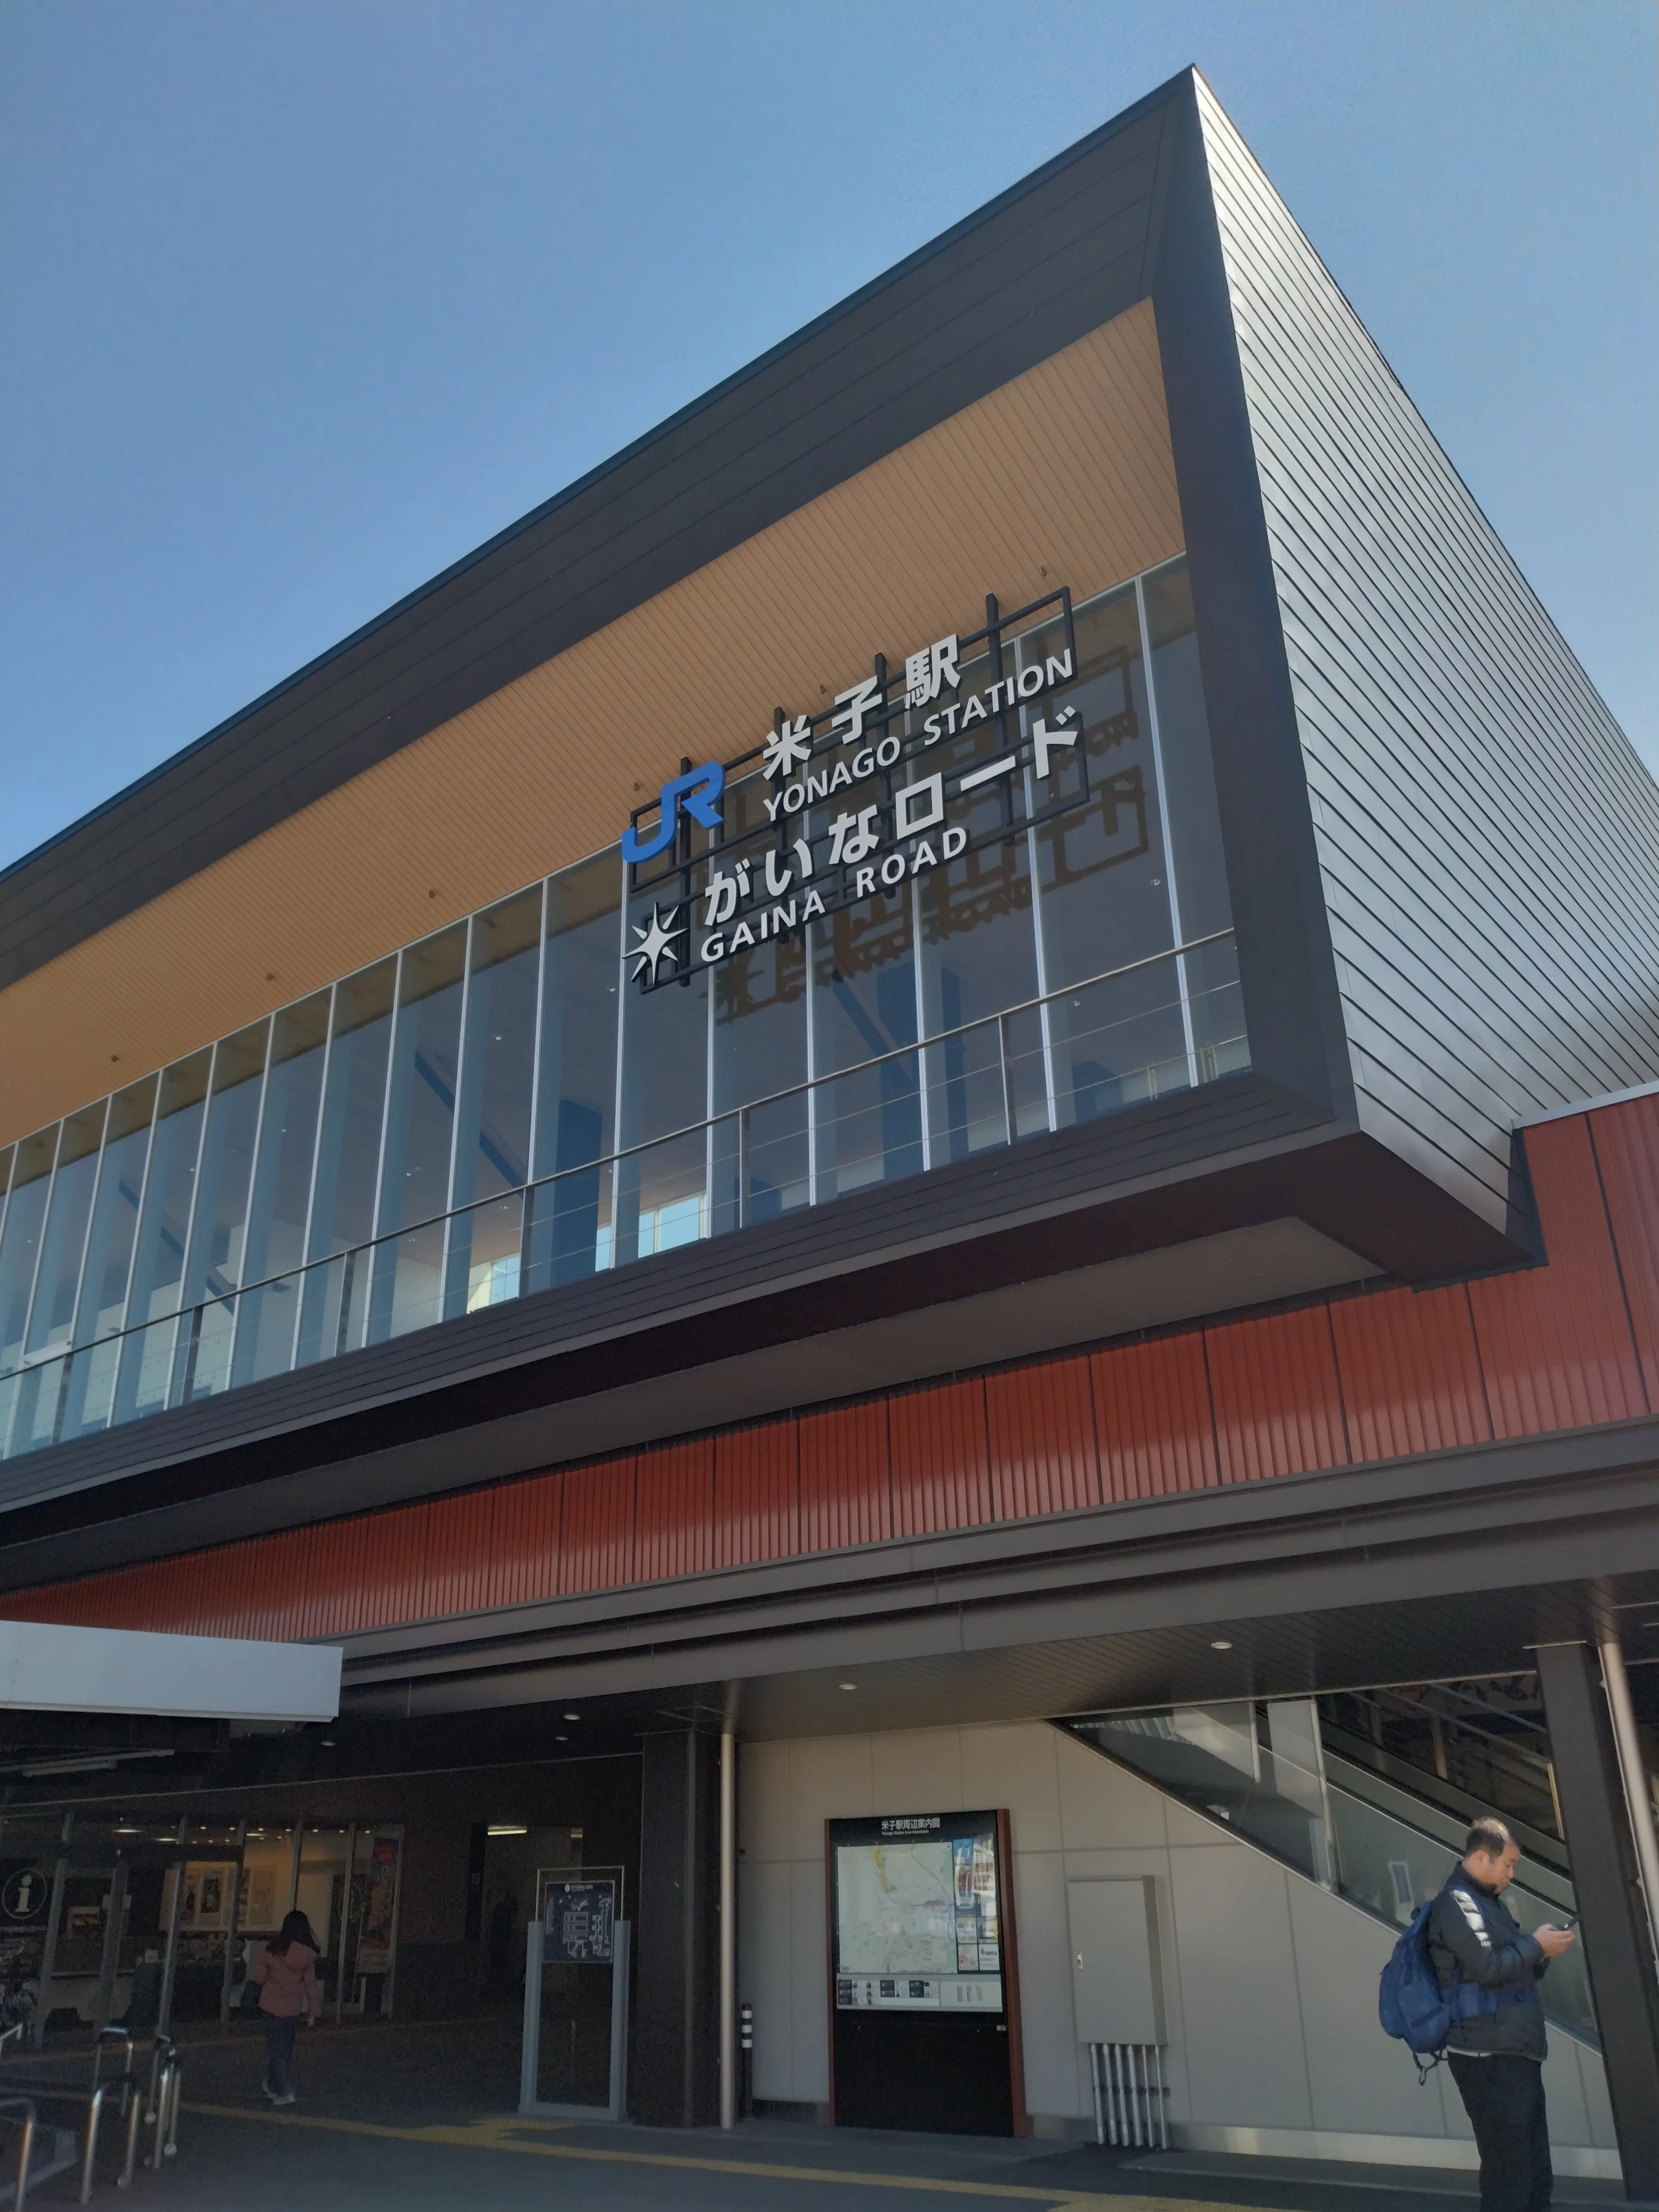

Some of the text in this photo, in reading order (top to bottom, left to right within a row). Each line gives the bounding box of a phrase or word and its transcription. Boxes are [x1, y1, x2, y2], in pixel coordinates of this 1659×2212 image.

[761, 633, 961, 782] 米子駅
[762, 648, 1074, 822] YONAGO STATION
[621, 760, 726, 864] JR
[704, 705, 1078, 927] がいなロード
[700, 826, 967, 962] GAINA ROAD
[882, 1818, 940, 1831] 米子駅周辺案内図
